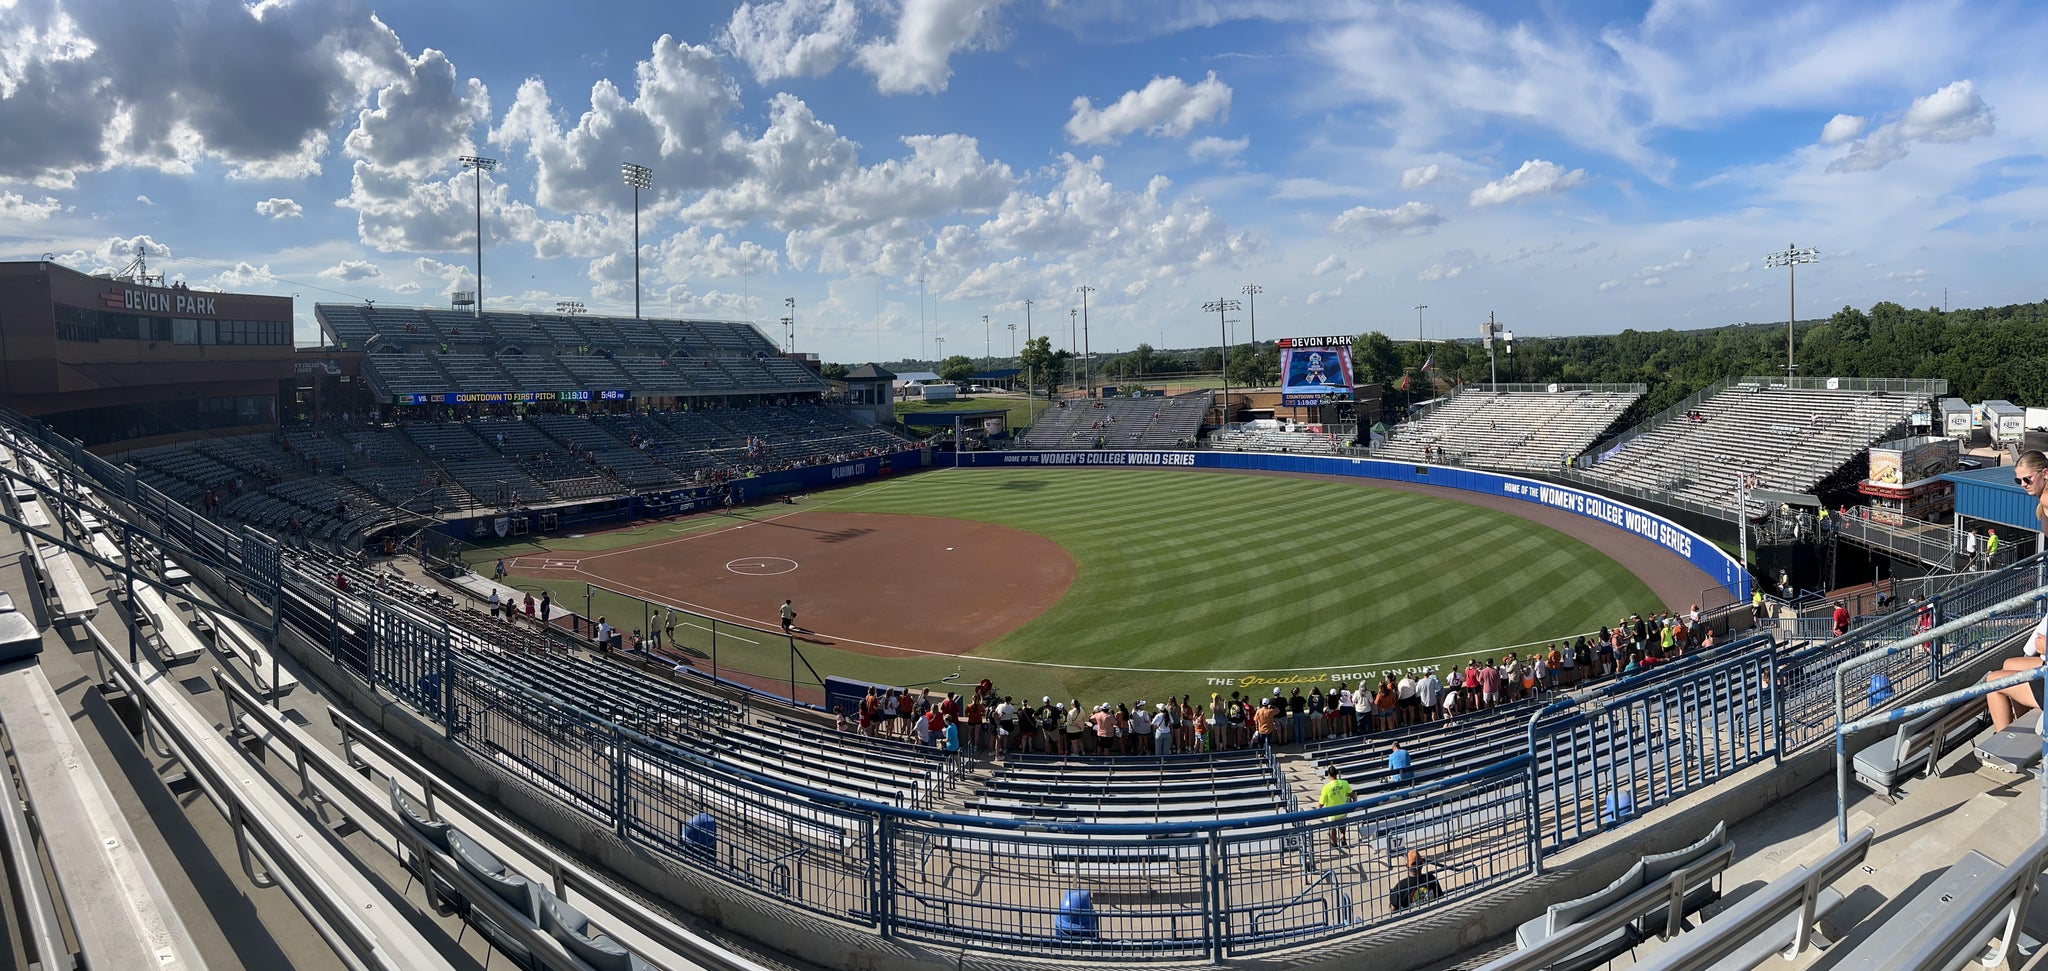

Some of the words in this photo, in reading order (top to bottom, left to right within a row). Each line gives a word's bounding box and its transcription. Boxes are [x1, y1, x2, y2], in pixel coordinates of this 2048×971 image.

[124, 289, 170, 312] DEVON
[176, 295, 216, 315] PARK
[1291, 337, 1323, 347] DEVON
[1326, 336, 1352, 346] PARK
[456, 393, 502, 402] COUNTDOWN
[504, 393, 512, 401] TO
[513, 392, 534, 401] FIRST
[535, 392, 556, 400] PITCH
[560, 391, 588, 400] 1:19:10
[601, 391, 617, 399] 5:48
[1040, 453, 1086, 464] WOMEN'S
[1086, 453, 1126, 464] COLLEGE
[1128, 453, 1161, 465] WORLD
[1162, 453, 1195, 466] SERIES
[1504, 482, 1520, 494] HOME
[1520, 485, 1529, 496] OF
[1529, 487, 1539, 498] THE
[1540, 486, 1584, 513] WOMEN'S
[1585, 497, 1624, 527] COLLEGE
[1625, 510, 1659, 541] WORLD
[1660, 523, 1692, 559] SERIES
[1206, 677, 1235, 686] THE
[1238, 673, 1327, 688] Greatest
[1331, 671, 1377, 682] SHOW
[1382, 668, 1403, 677] ON
[1286, 837, 1298, 846] 16
